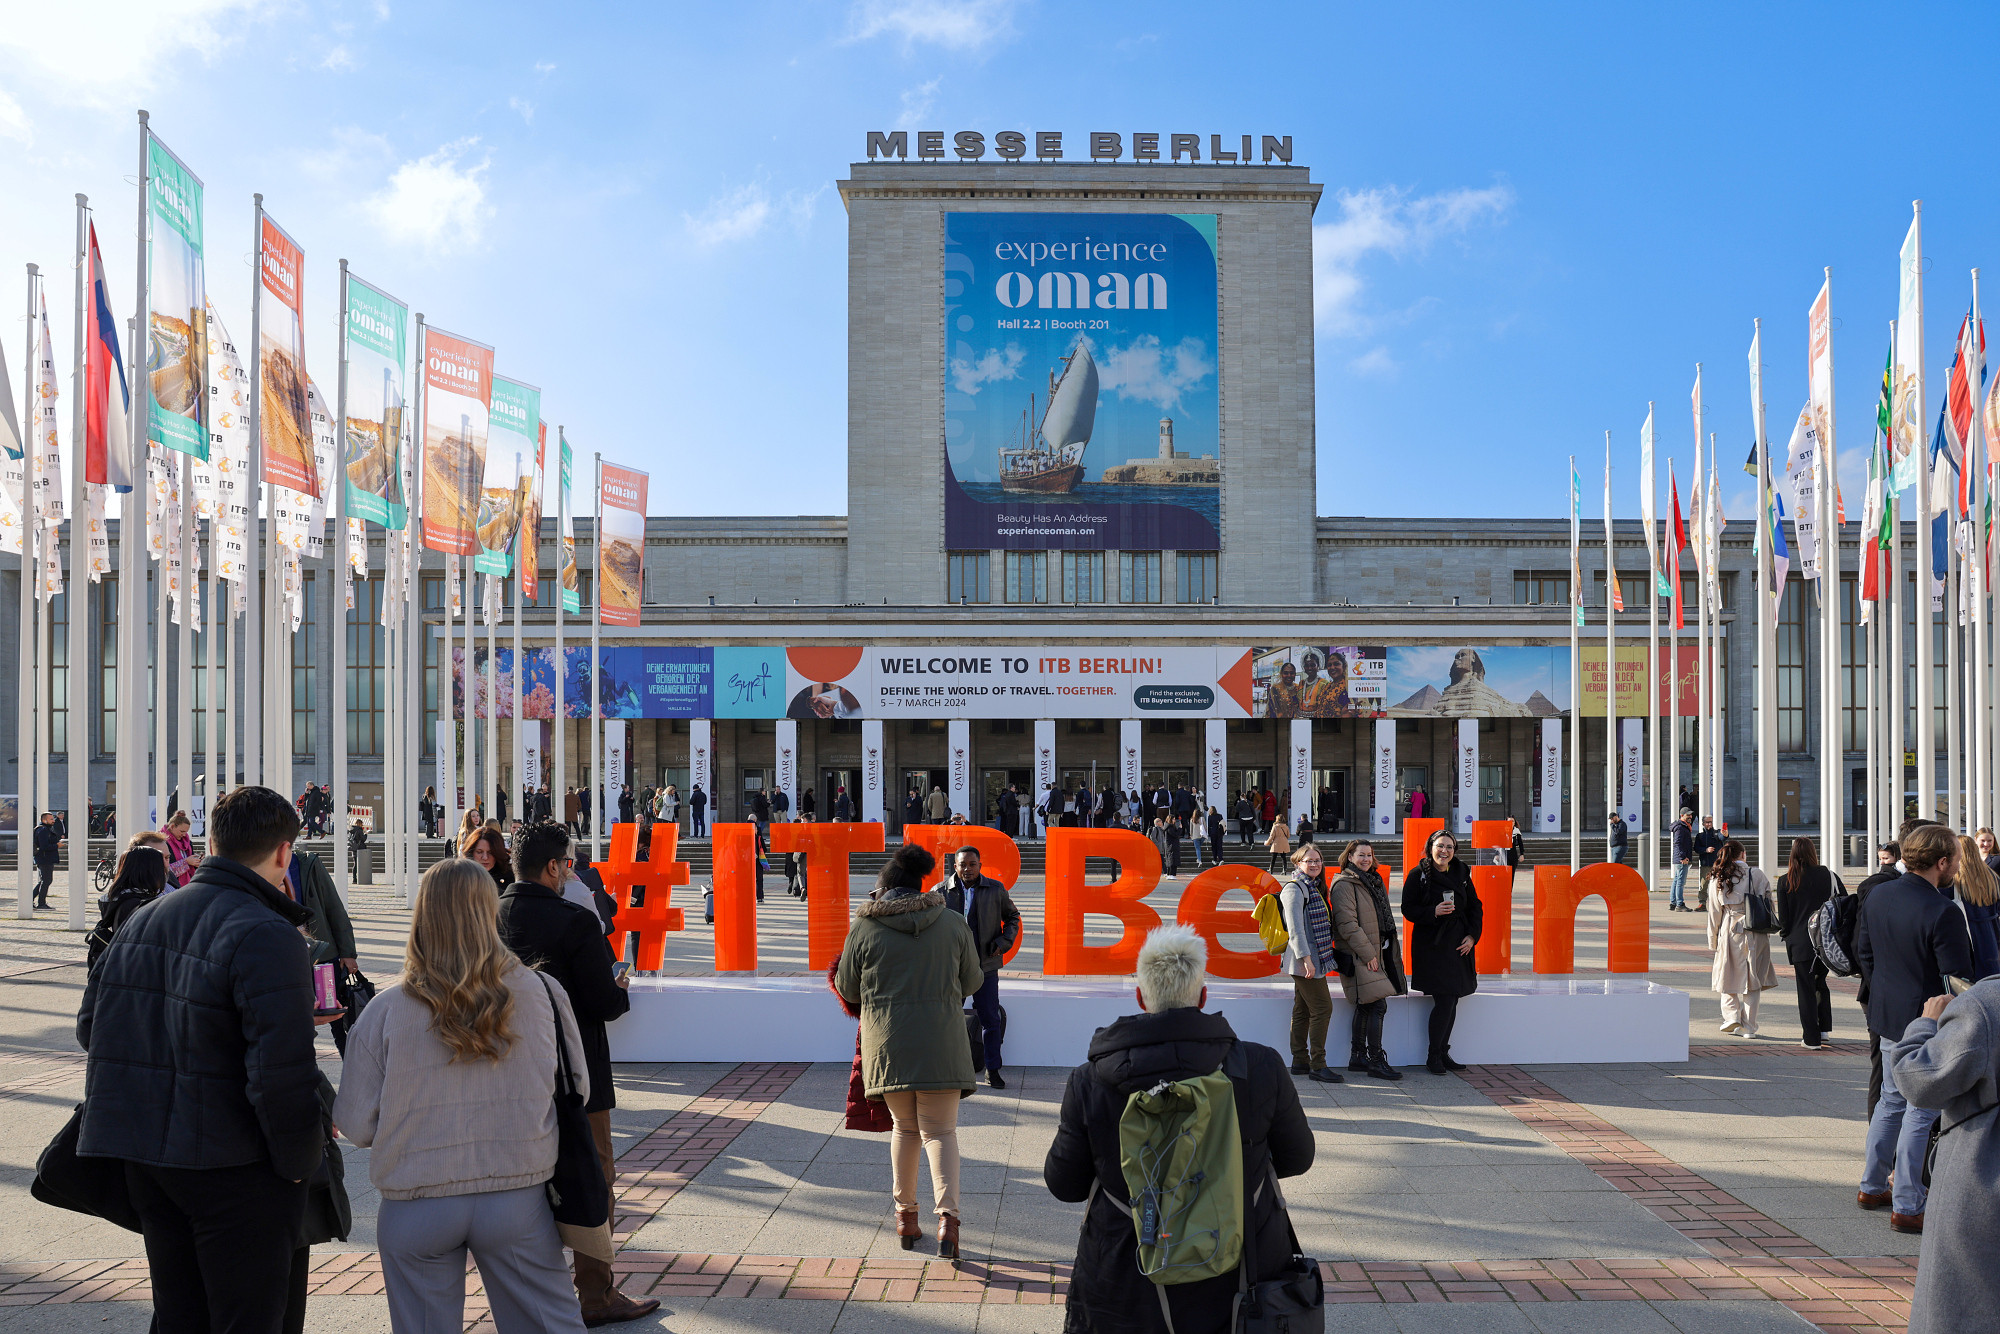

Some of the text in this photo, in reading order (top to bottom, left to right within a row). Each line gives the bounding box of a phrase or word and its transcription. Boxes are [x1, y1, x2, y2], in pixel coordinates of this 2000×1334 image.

[867, 131, 1292, 162] MESSE BERLIN
[154, 176, 192, 225] oman
[263, 237, 295, 271] experience
[995, 236, 1167, 267] experience
[263, 250, 294, 290] oman
[995, 272, 1167, 309] oman
[351, 296, 395, 323] experience
[350, 308, 394, 341] oman
[359, 331, 367, 340] 2.2
[997, 319, 1109, 330] Hall 2.2 Booth 201
[430, 346, 480, 368] experience
[429, 357, 480, 383] oman
[429, 373, 478, 393] Hall 2.2 Booth 201
[194, 475, 211, 484] ITB
[219, 480, 234, 490] ITB
[604, 475, 639, 488] experience
[604, 483, 638, 500] oman
[295, 513, 311, 522] ITB
[997, 514, 1108, 524] Beauty Has An Address
[308, 536, 323, 545] ITB
[997, 526, 1095, 537] experienceoman.om
[226, 541, 241, 551] ITB
[665, 663, 710, 673] ERWARTUNGEN
[880, 657, 1162, 674] WELCOME TO ITB BERLIN!
[1369, 661, 1384, 670] ITB
[1601, 662, 1644, 672] ERARTUNGEN
[686, 674, 701, 684] DER
[1621, 672, 1635, 682] DER
[1633, 683, 1642, 692] AN
[698, 684, 708, 694] AN
[880, 686, 1117, 696] DEFINE THE WORLD OF TRAVEL. TOGETHER.
[880, 698, 887, 707] 5
[896, 698, 903, 707] 7
[905, 698, 941, 707] MARCH
[943, 698, 967, 707] 2024
[1151, 697, 1173, 705] Buyers
[610, 759, 619, 790] QATAR
[695, 759, 704, 789] QATAR
[782, 760, 790, 791] QATAR
[868, 760, 877, 791] QATAR
[954, 760, 963, 791] QATAR
[1040, 760, 1048, 791] QATAR
[1126, 760, 1135, 790] QATAR
[1212, 759, 1221, 790] QATAR
[1297, 758, 1306, 789] QATAR
[1381, 758, 1390, 789] QATAR
[1464, 758, 1474, 788] QATAR
[1547, 757, 1557, 787] QATAR
[1628, 757, 1637, 787] QATAR
[1144, 1203, 1154, 1233] EXPED
